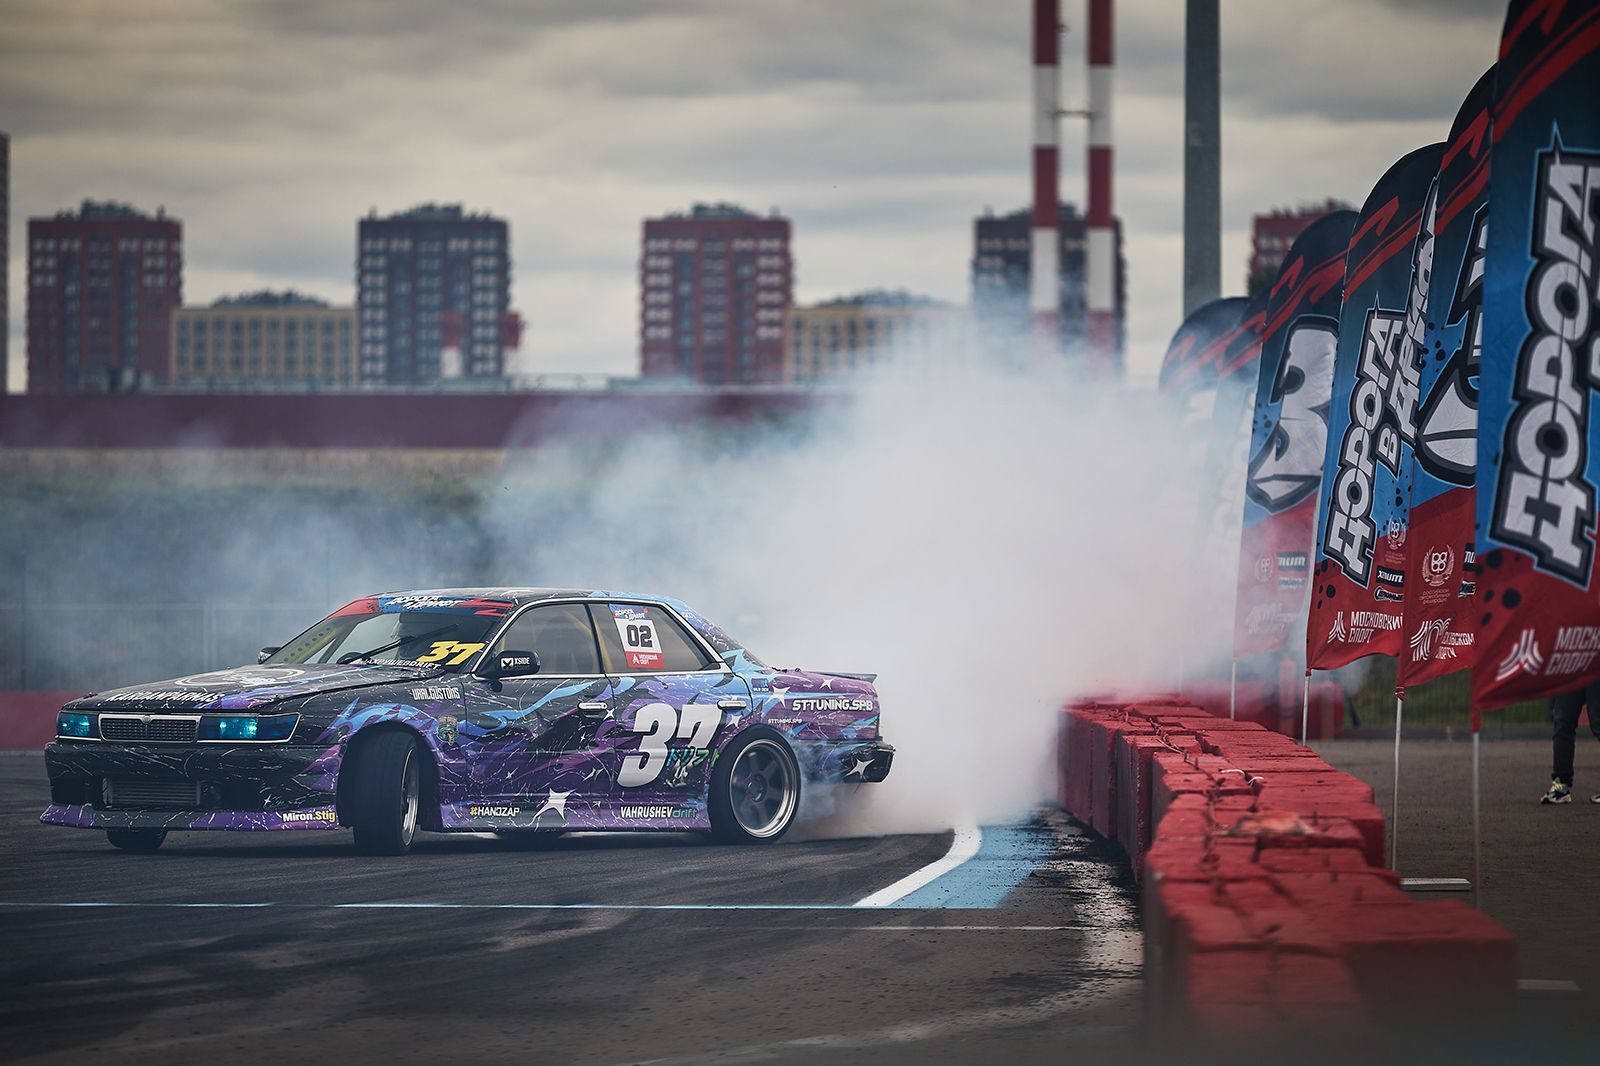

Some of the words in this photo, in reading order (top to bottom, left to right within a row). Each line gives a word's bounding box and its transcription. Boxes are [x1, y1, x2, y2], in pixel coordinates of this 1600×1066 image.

[1504, 153, 1600, 568] ДОРОГА
[1329, 309, 1403, 575] ДОРОГА
[626, 624, 653, 648] 02
[1348, 629, 1375, 644] СПОРТ
[1554, 626, 1600, 650] МОСК
[415, 640, 485, 665] 37
[1545, 651, 1598, 675] СПОРТ
[617, 703, 722, 787] 37
[283, 811, 336, 822] Miron.Stig
